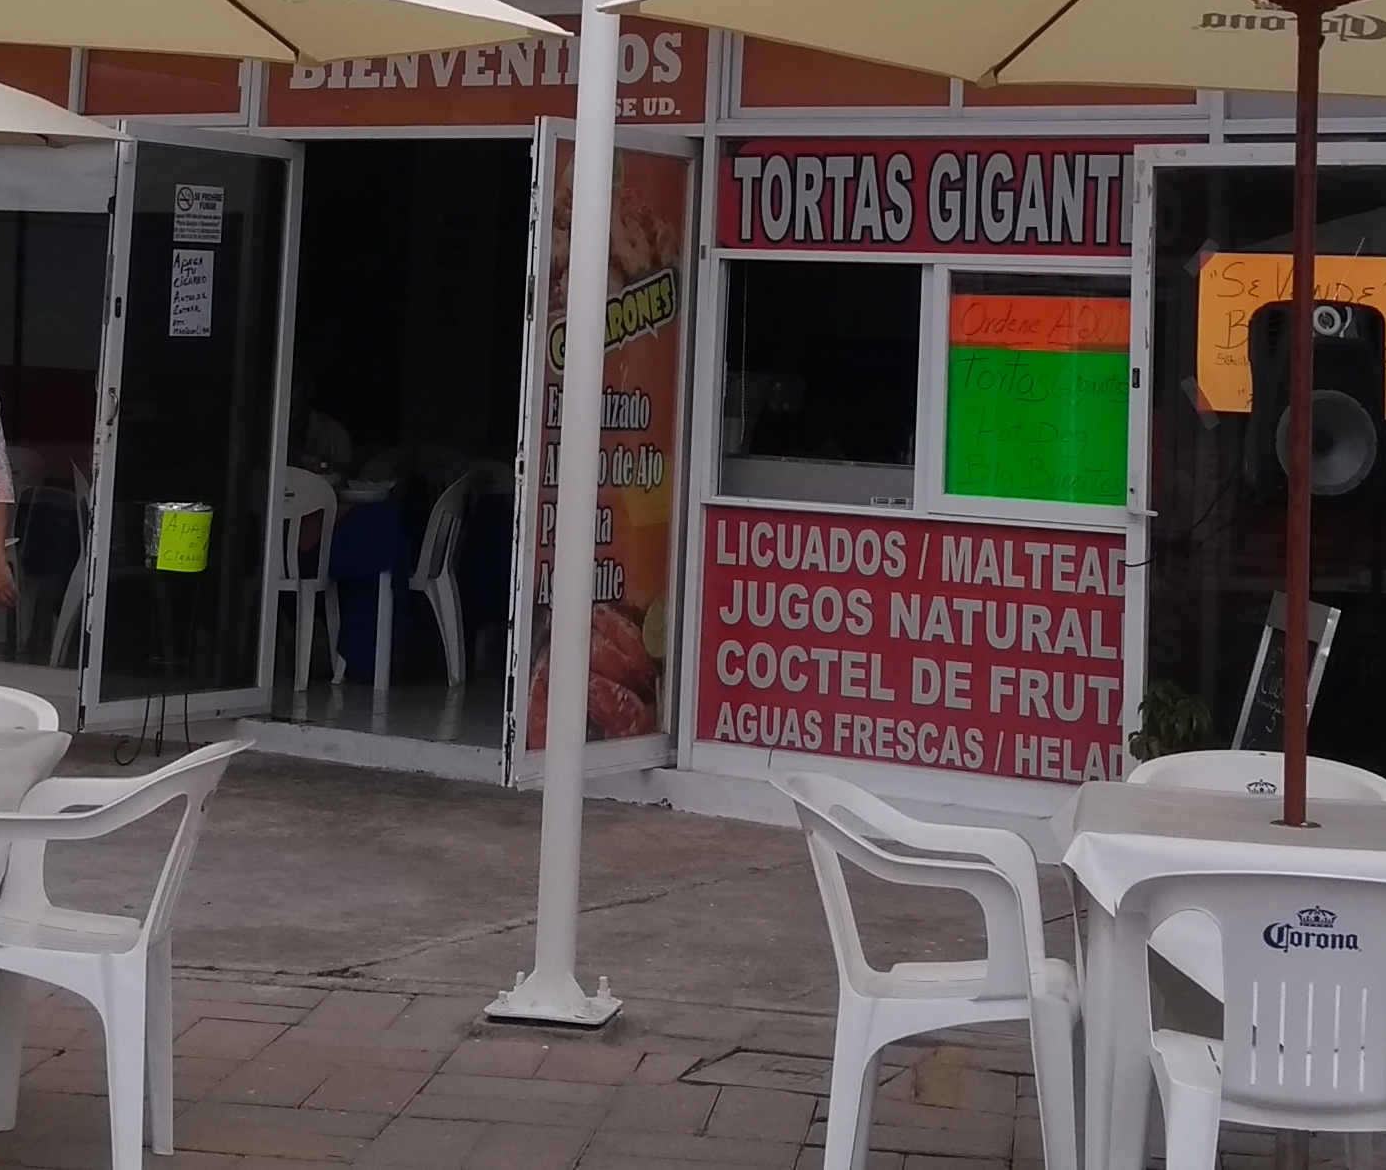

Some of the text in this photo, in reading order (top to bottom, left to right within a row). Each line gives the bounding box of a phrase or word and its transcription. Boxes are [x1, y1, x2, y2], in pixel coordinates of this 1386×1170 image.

[733, 153, 915, 244] TORTAS
[612, 445, 634, 487] de
[636, 445, 665, 492] Ajo
[716, 519, 906, 578] LICUADOS
[719, 579, 1125, 661] JUGOS NATURAL
[716, 639, 1124, 727] COCTEL DE FRUT
[714, 701, 823, 750] AGUAS
[833, 712, 984, 770] FRESCAS
[1263, 922, 1360, 954] Corona
